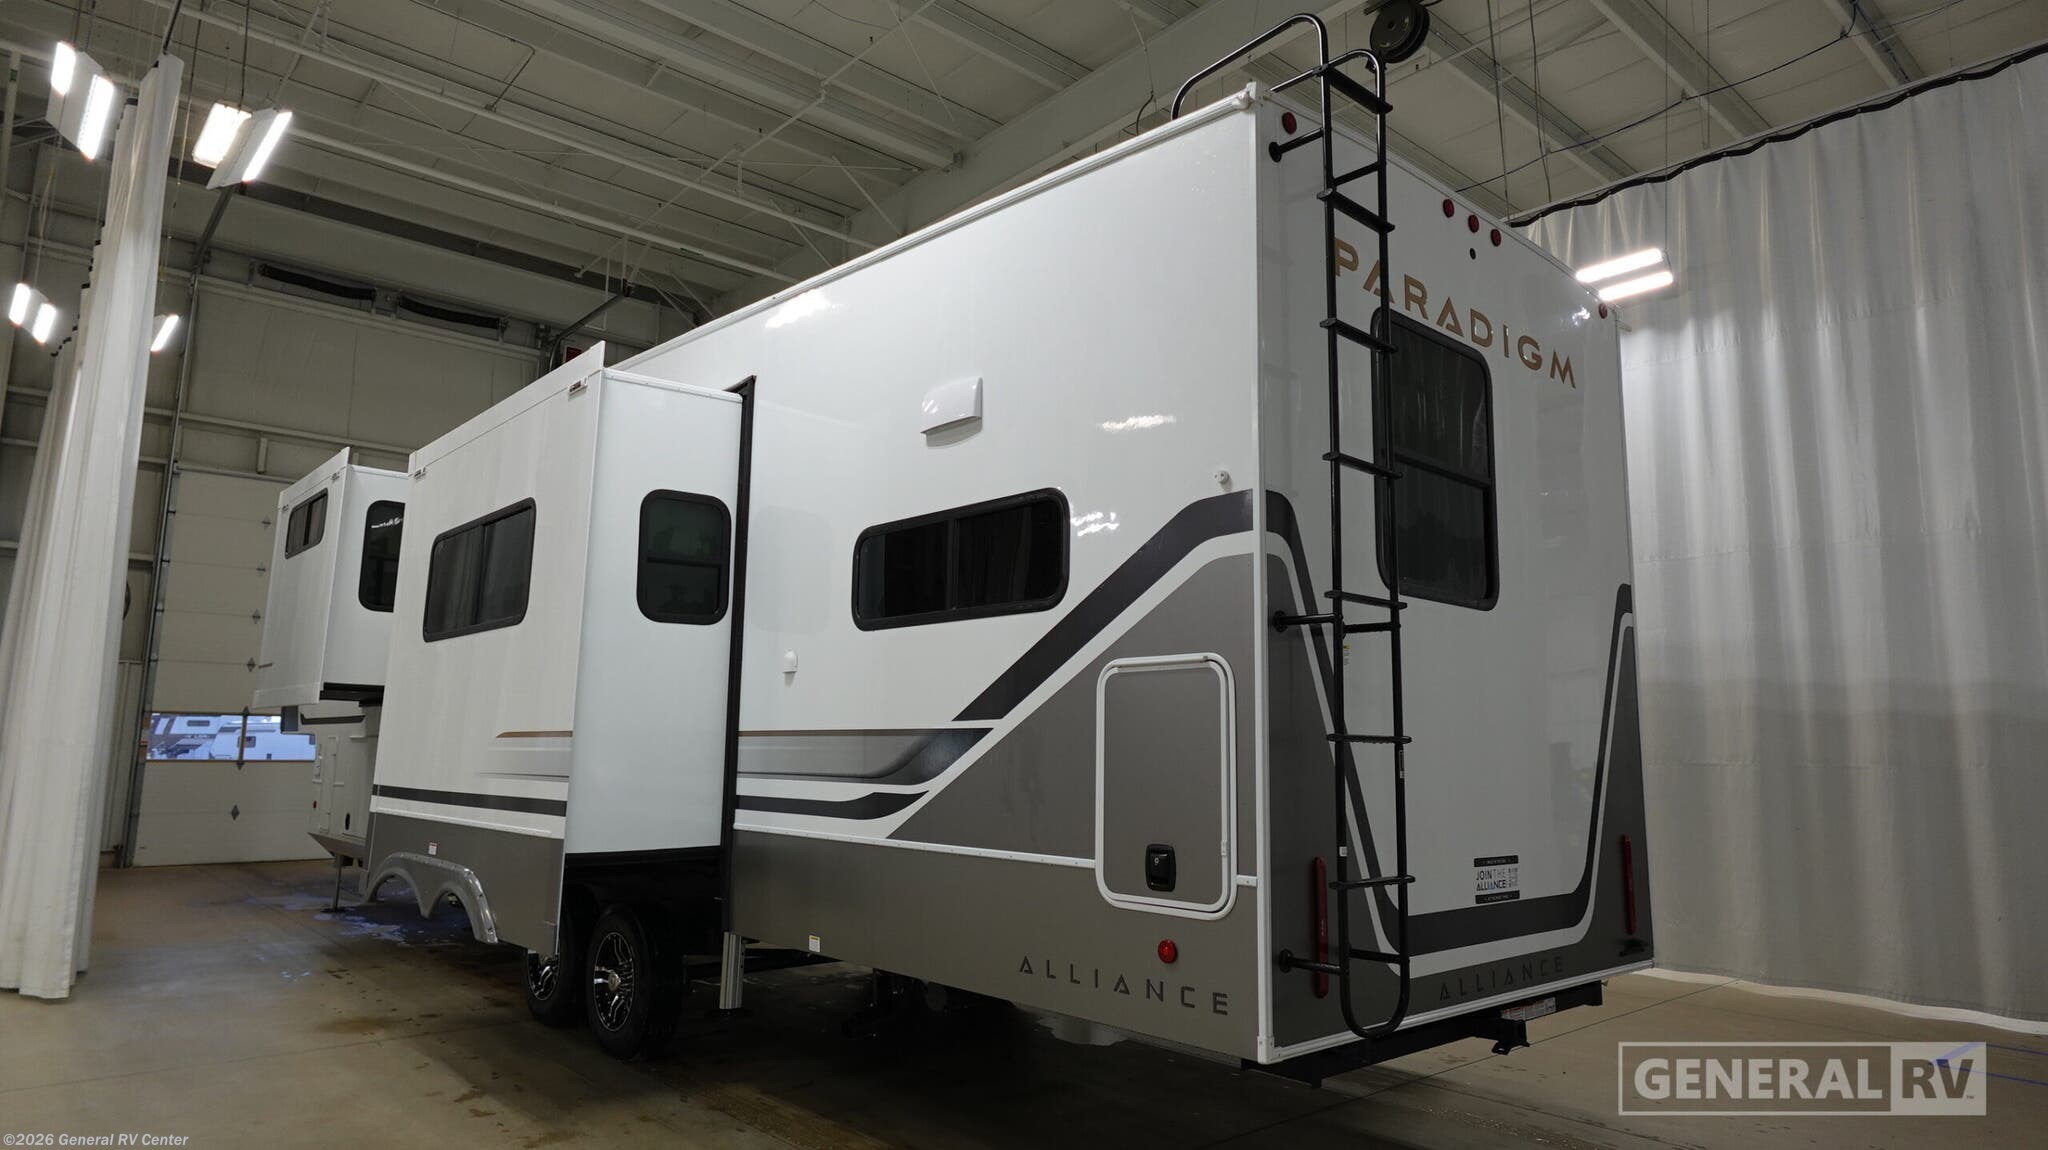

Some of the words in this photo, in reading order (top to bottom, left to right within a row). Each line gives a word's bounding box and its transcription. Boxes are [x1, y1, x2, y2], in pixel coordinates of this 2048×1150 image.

[1334, 238, 1576, 389] PARADIGM
[1476, 870, 1492, 880] JOIN
[1476, 879, 1506, 891] ALLIANCE
[1019, 955, 1228, 1016] ALLIANCE
[1440, 956, 1564, 1001] ALLIANCE
